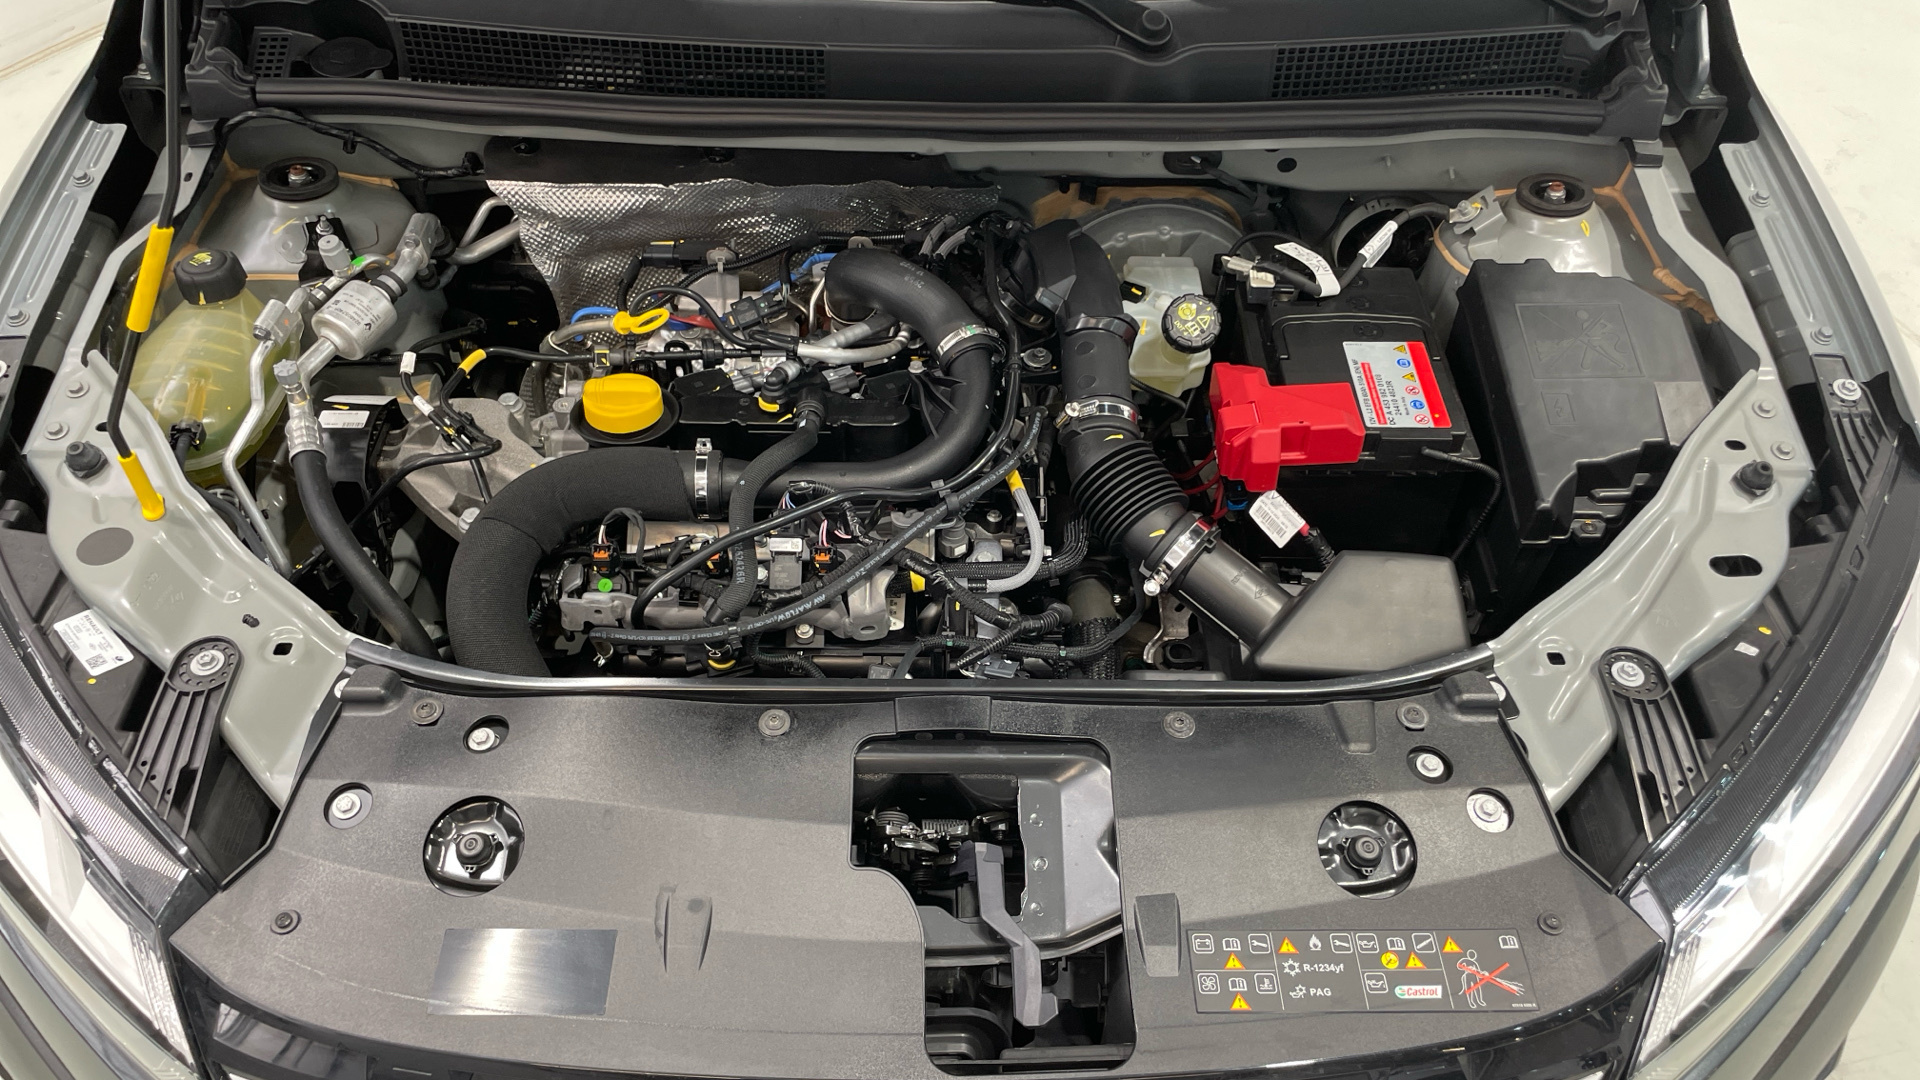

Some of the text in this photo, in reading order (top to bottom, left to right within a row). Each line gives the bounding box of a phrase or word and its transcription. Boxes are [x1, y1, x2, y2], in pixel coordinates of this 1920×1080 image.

[1302, 964, 1344, 974] R-1234yf
[1310, 988, 1332, 996] PAG
[1406, 988, 1439, 996] Castrol
